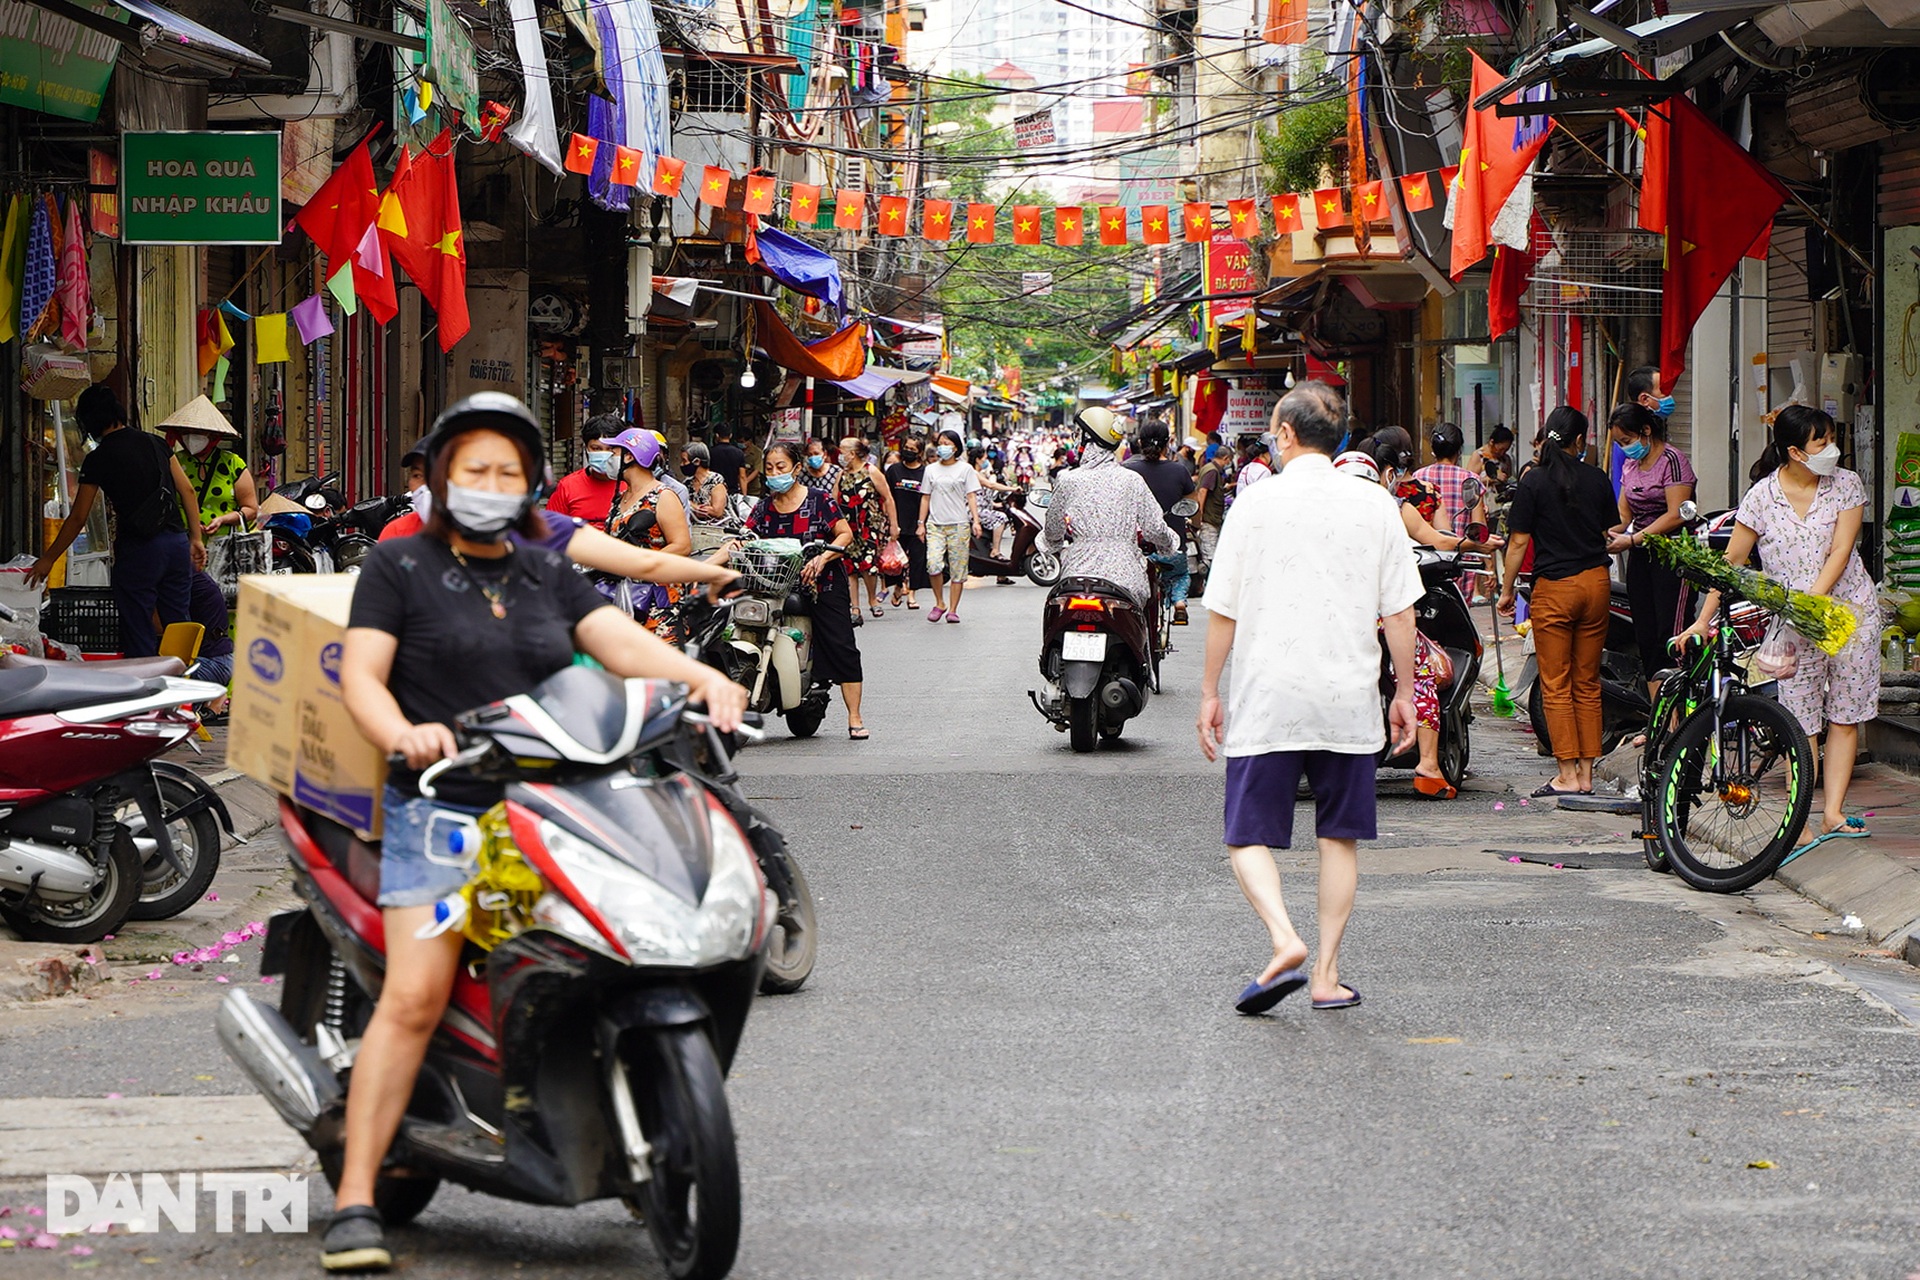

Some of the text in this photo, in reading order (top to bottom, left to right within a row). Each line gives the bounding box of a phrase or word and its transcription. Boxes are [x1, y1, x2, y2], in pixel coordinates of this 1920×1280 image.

[147, 156, 256, 178] HOA QUẢ
[132, 193, 197, 218] NHẬP
